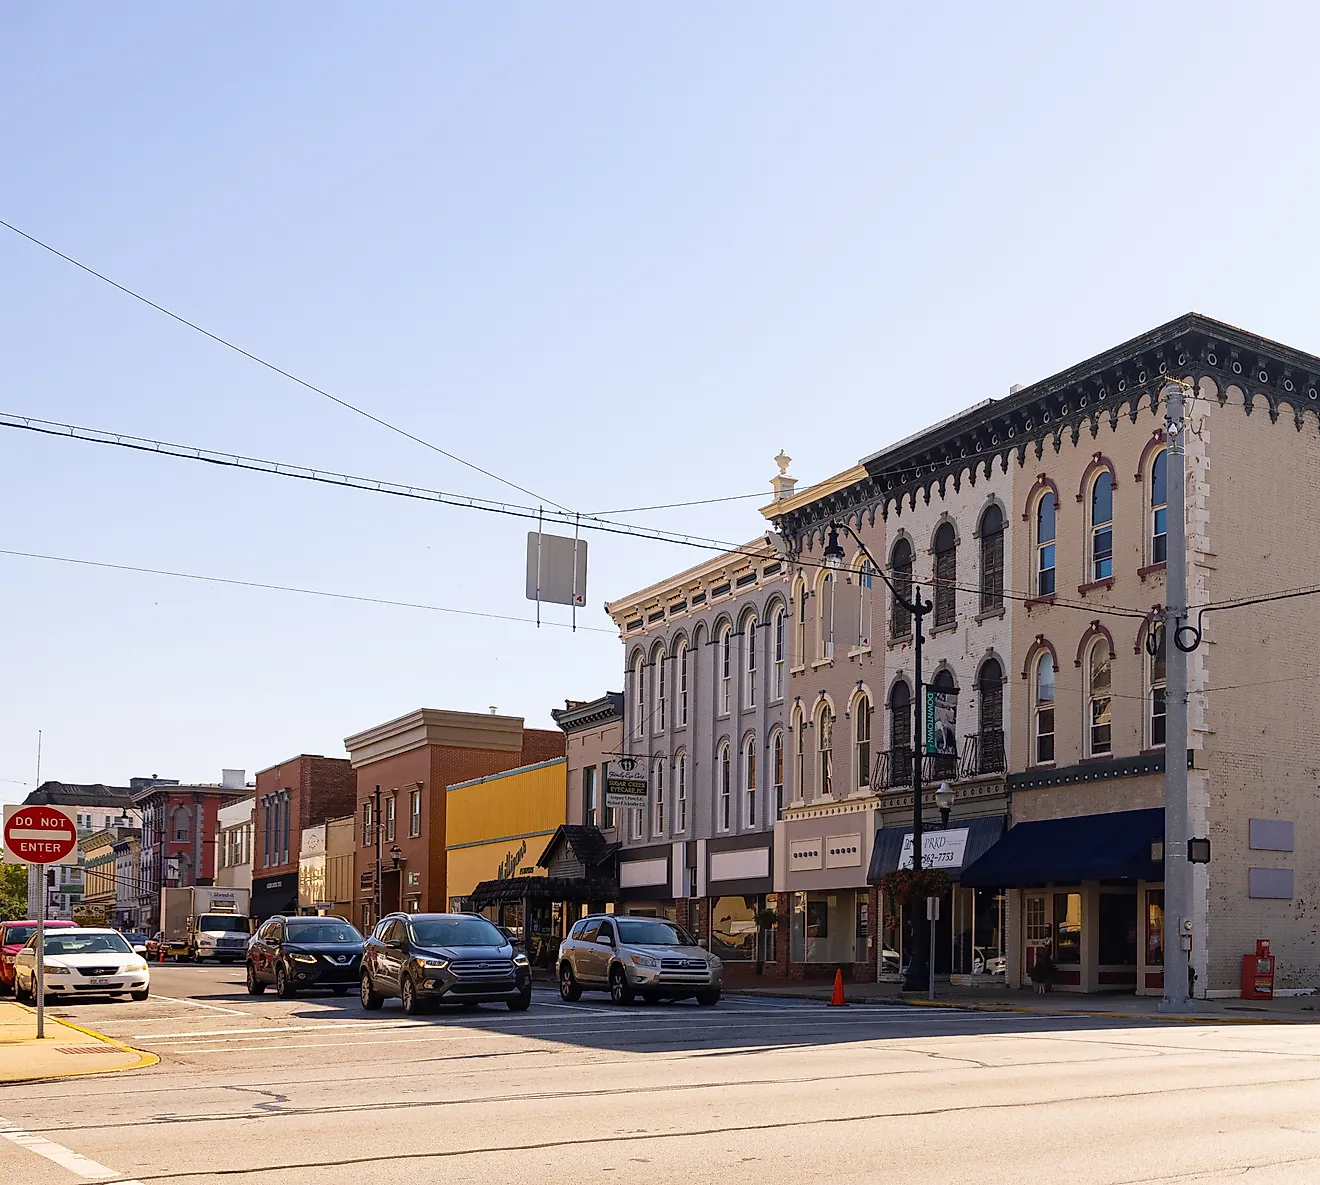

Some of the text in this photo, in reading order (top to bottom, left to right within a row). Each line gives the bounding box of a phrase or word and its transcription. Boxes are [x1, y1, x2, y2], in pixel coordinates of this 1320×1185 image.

[15, 816, 66, 828] DO NOT
[20, 842, 61, 853] ENTER
[74, 904, 105, 914] MEXICO
